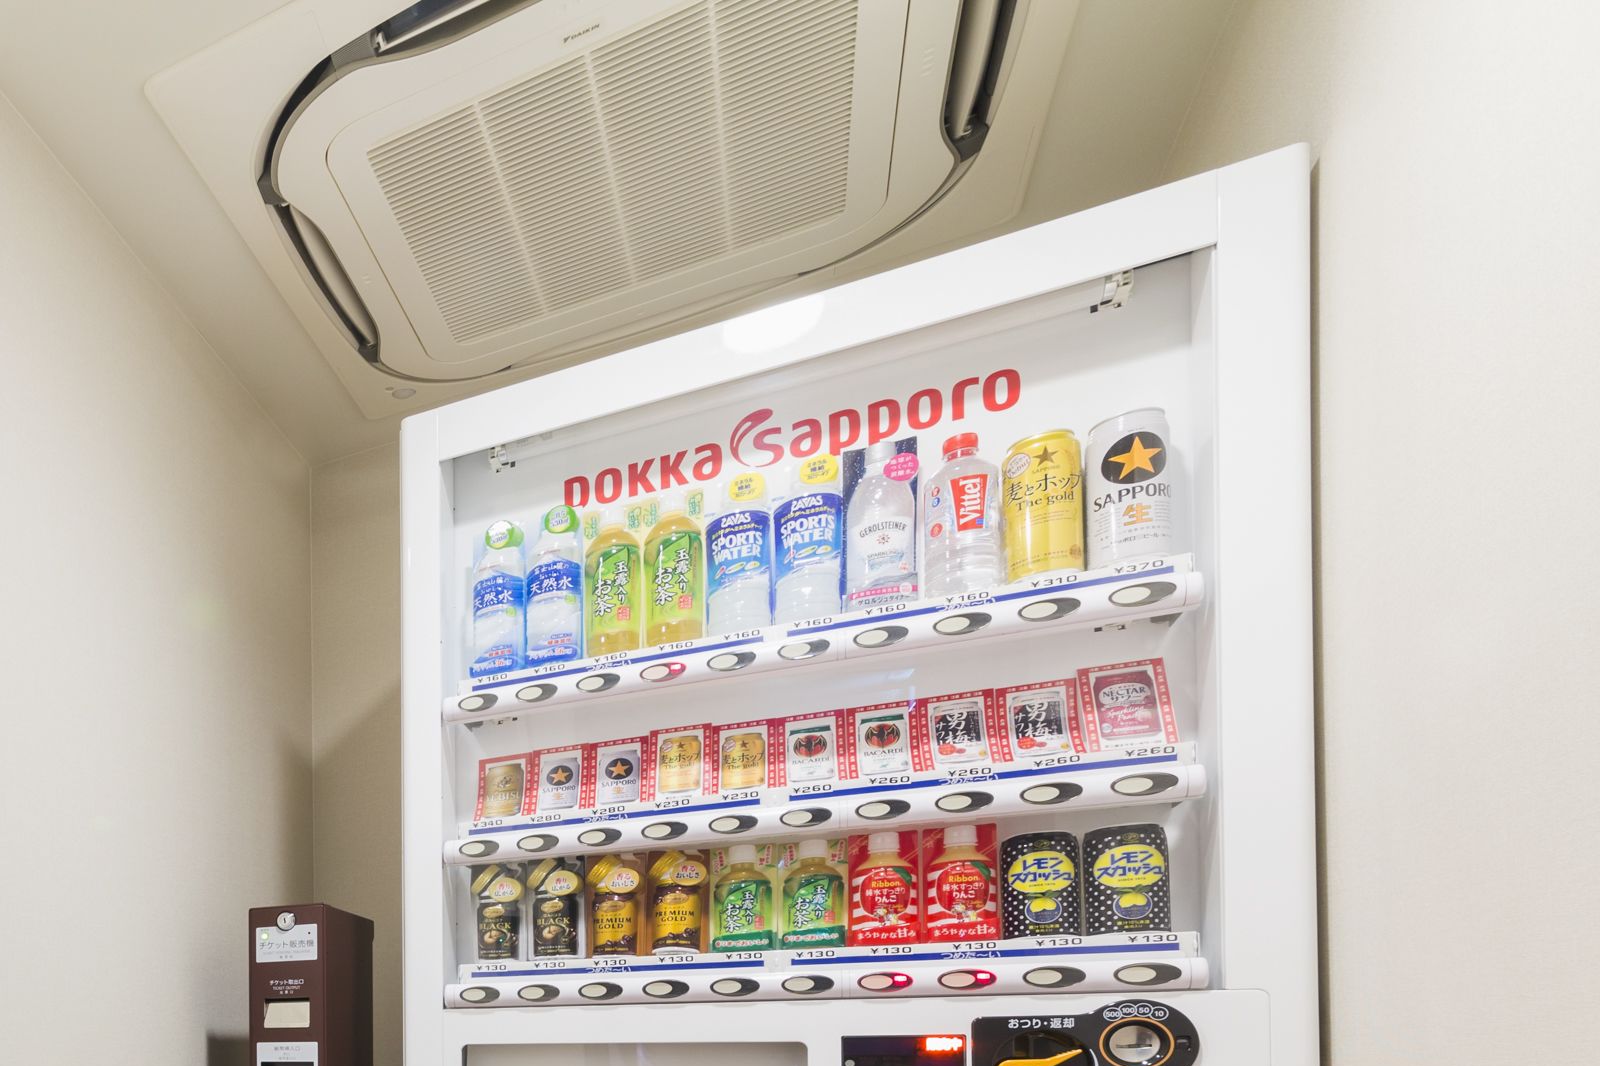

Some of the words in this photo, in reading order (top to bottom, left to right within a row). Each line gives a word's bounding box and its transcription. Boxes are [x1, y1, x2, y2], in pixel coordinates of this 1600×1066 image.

[1006, 473, 1082, 507] 麦とホップ
[959, 477, 981, 526] Vittel
[1015, 496, 1043, 512] The
[1046, 490, 1075, 506] gold
[1122, 502, 1153, 527] 生
[780, 514, 836, 539] SPORTS
[859, 520, 908, 539] GEROLSTEINER
[711, 531, 763, 555] SPORTS
[782, 528, 834, 549] WATER
[713, 545, 762, 566] WATER
[674, 547, 691, 594] 玉露入り
[1114, 559, 1164, 575] ¥370
[529, 575, 575, 598] 天然水
[614, 560, 630, 604] 玉露入り
[654, 567, 677, 606] お茶
[1031, 574, 1078, 589] ¥310
[473, 588, 515, 610] 天然水
[593, 579, 616, 618] お茶
[946, 591, 990, 603] ¥160
[865, 602, 907, 616] ¥160
[793, 616, 833, 629] ¥160
[723, 629, 761, 641] ¥160
[659, 641, 694, 652] ¥160
[594, 652, 628, 664] ¥160
[534, 663, 566, 674] ¥160
[477, 673, 508, 684] ¥160
[1102, 686, 1147, 699] NECTAR
[1023, 701, 1053, 738] 男梅
[944, 711, 972, 745] 男梅
[1125, 745, 1176, 757] ¥260
[661, 752, 701, 766] 麦とホップ
[722, 751, 765, 766] 麦とホップ
[1034, 754, 1081, 768] ¥260
[948, 767, 992, 778] ¥260
[601, 778, 637, 788] SAPPORO
[869, 775, 911, 785] ¥260
[542, 784, 576, 794] SAPPORO
[793, 784, 832, 794] ¥260
[722, 790, 760, 801] ¥230
[655, 798, 691, 809] ¥230
[592, 805, 626, 815] ¥280
[473, 819, 503, 828] ¥340
[531, 814, 562, 823] ¥280
[1110, 850, 1154, 865] レモン
[1022, 857, 1064, 871] レモン
[1010, 869, 1074, 886] スカッシュ
[1097, 863, 1164, 880] スカッシュ
[871, 880, 900, 889] Ribbon
[948, 875, 979, 883] Ribbon
[875, 895, 897, 904] りんご
[953, 890, 976, 899] りんご
[741, 891, 755, 926] 玉露入り
[812, 885, 826, 920] 玉露入り
[725, 903, 743, 934] お茶
[794, 897, 812, 929] お茶
[480, 922, 512, 930] BLACK
[536, 916, 571, 926] BLACK
[857, 927, 917, 940] まろやかな甘み
[933, 923, 997, 938] まろやかな甘み
[259, 939, 315, 950] チケット販売機
[1036, 937, 1083, 947] ¥130
[1128, 933, 1179, 944] ¥130
[870, 946, 912, 956] ¥130
[952, 941, 997, 950] ¥130
[658, 955, 694, 964] ¥130
[725, 952, 763, 961] ¥130
[795, 950, 835, 959] ¥130
[476, 964, 507, 972] ¥130
[534, 961, 566, 969] ¥130
[593, 958, 627, 967] ¥130
[1105, 1009, 1121, 1019] 500
[1122, 1006, 1136, 1014] 100
[1138, 1005, 1150, 1014] 50
[1154, 1009, 1165, 1018] 10
[1007, 1018, 1076, 1029] おつり・返却
